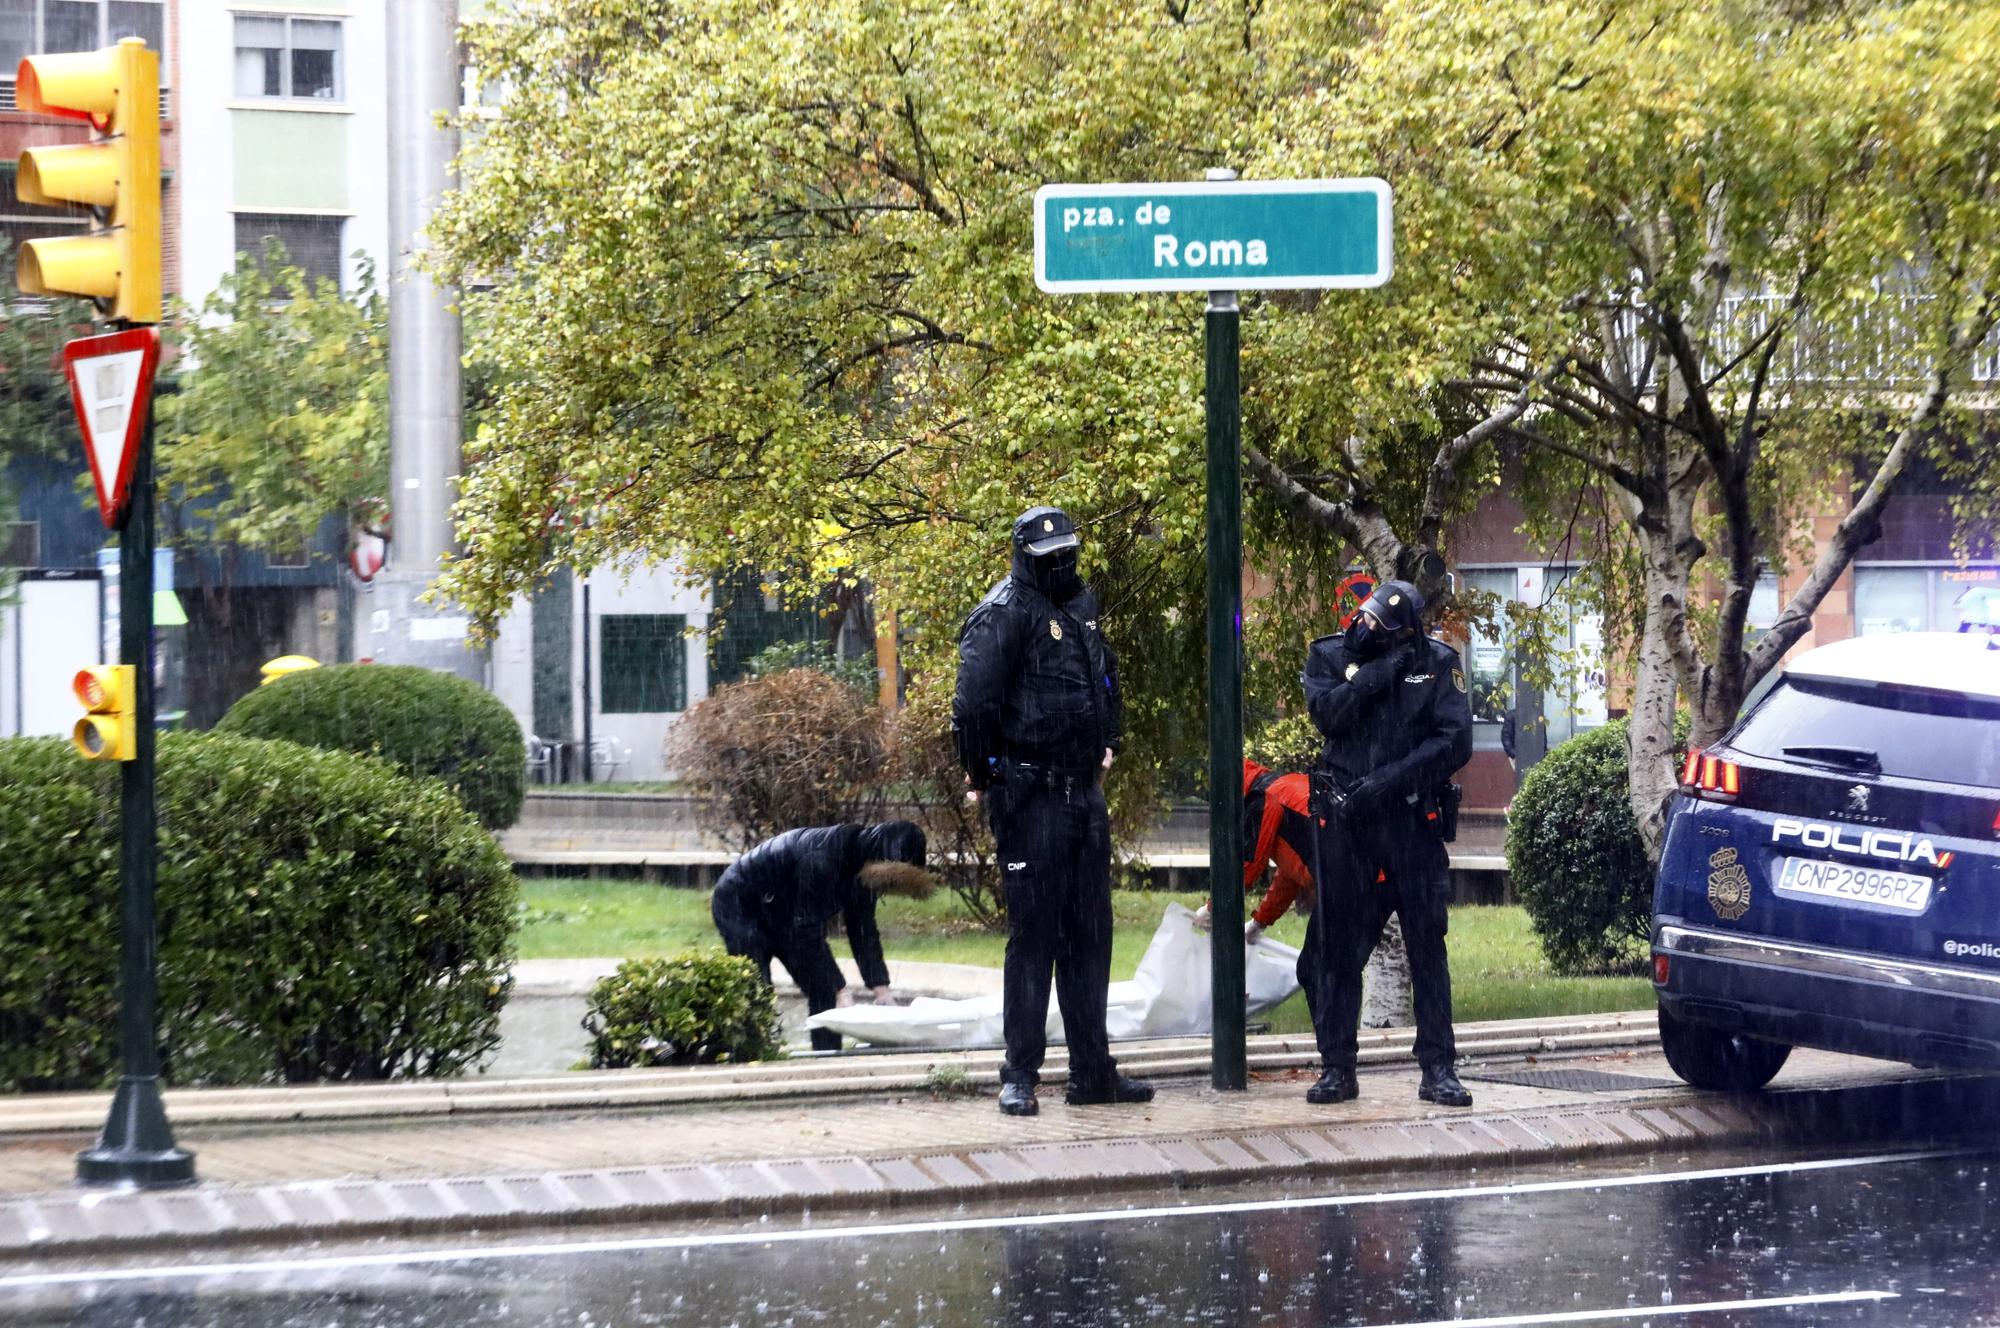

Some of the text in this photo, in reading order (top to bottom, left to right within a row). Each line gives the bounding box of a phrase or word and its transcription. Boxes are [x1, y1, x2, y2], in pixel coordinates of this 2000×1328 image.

[1063, 201, 1171, 232] pza. de
[1154, 234, 1268, 267] Roma
[1771, 818, 1939, 865] POLICÍA
[1007, 862, 1027, 871] CNP
[1796, 863, 1925, 905] CNP2996RZ
